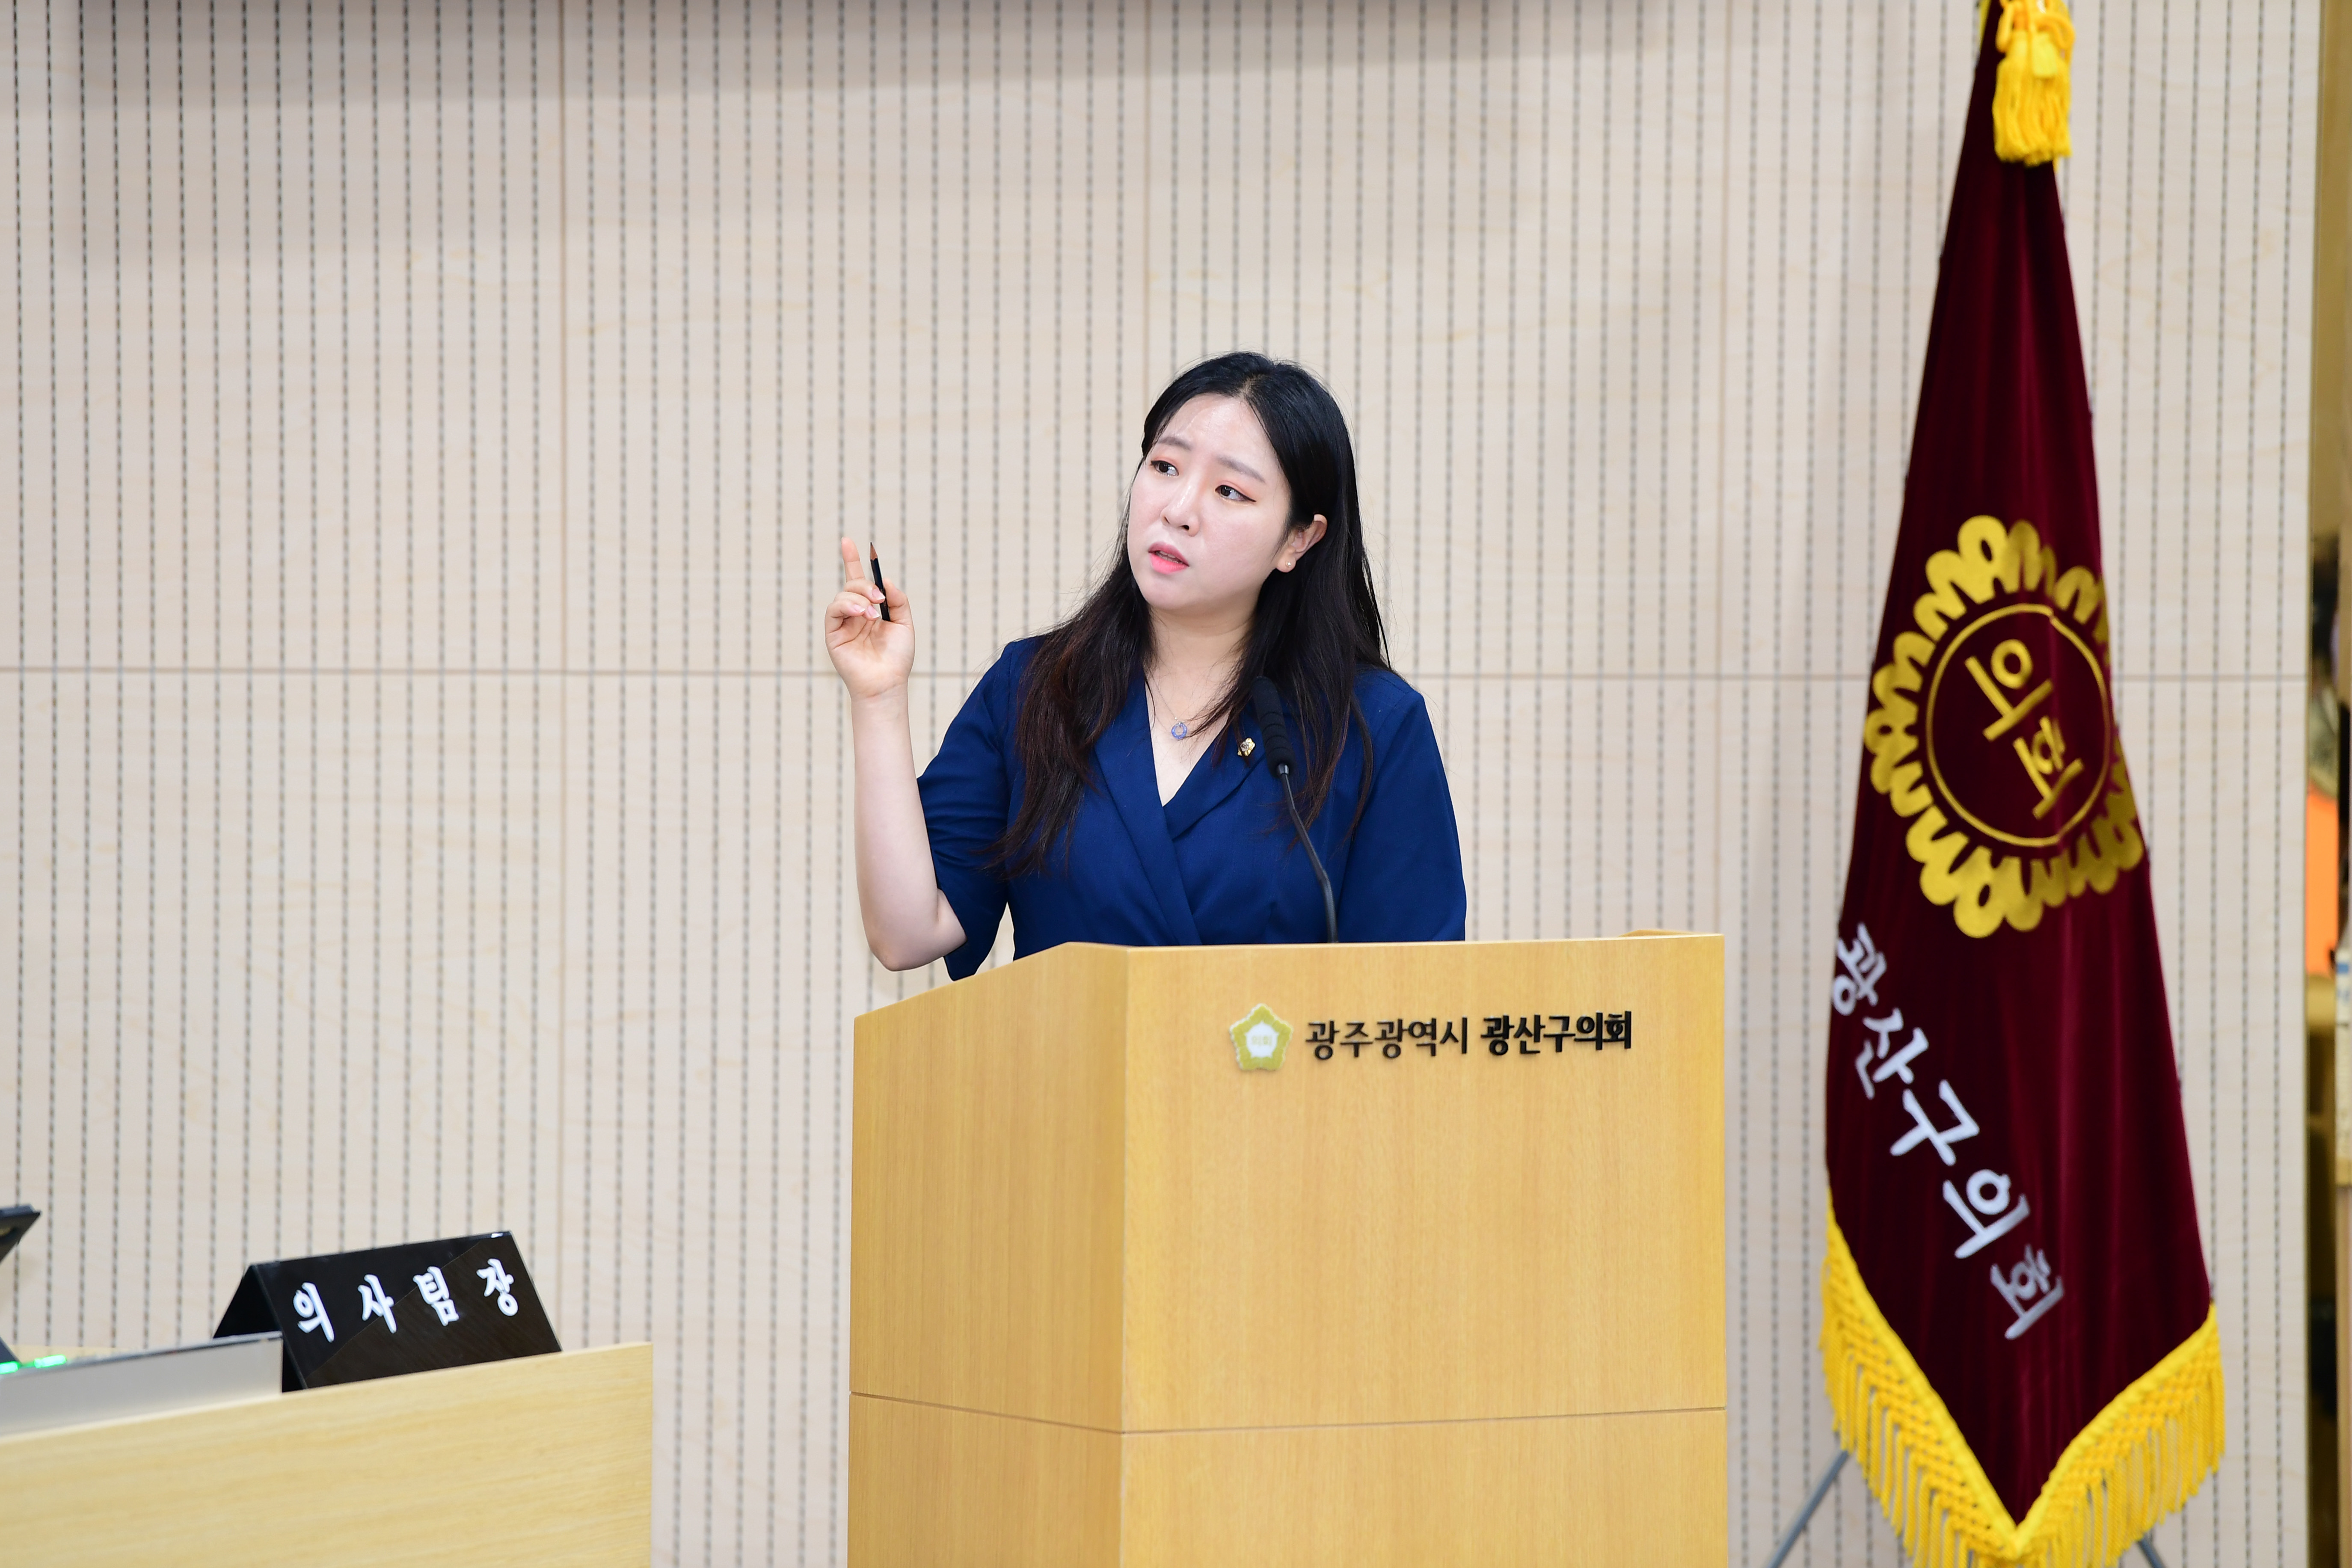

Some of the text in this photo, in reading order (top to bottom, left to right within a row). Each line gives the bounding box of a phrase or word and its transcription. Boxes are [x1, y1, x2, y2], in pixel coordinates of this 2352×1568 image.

[1965, 639, 2083, 818] 의회
[1305, 1011, 1631, 1060] 광주광역시 광산구의회
[1833, 922, 2064, 1340] 광산구의회
